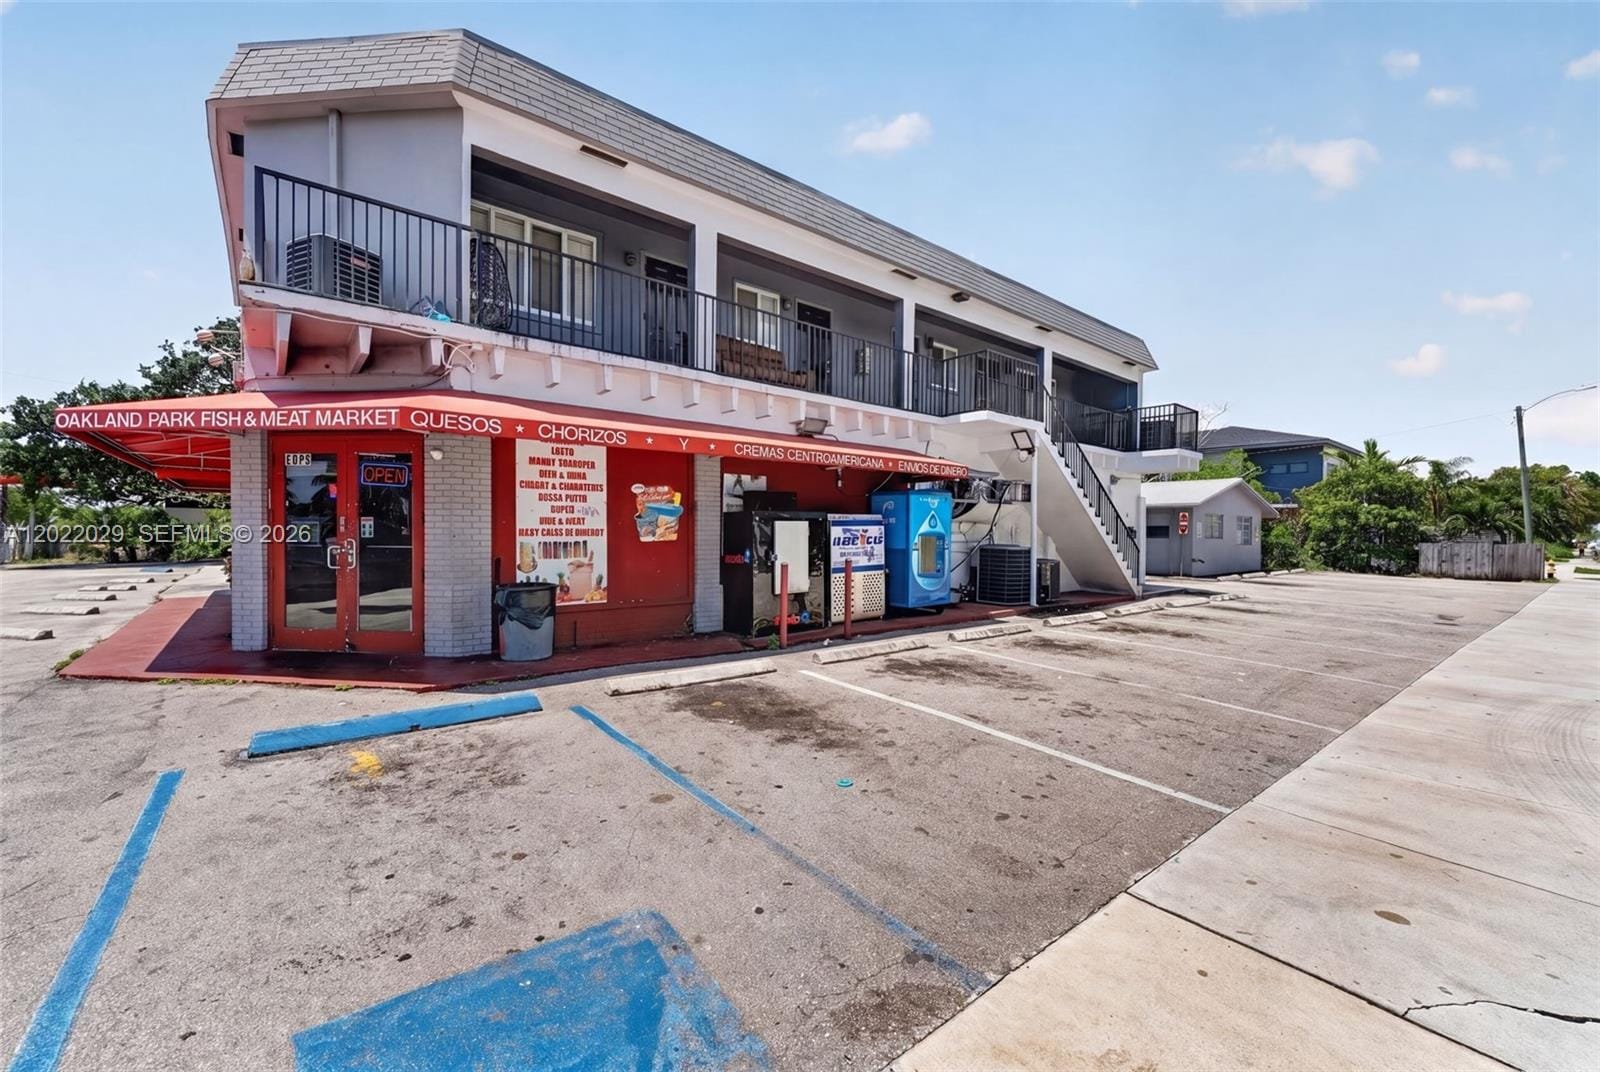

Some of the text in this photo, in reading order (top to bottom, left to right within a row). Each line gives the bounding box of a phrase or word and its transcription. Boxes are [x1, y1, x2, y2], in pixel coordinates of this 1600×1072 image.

[55, 408, 400, 428] OAKLAND PARK FISH & MEAT MARKET
[410, 410, 502, 434] QUESOS
[538, 423, 627, 445] CHORIZOS
[679, 437, 689, 450] Y
[734, 443, 784, 459] CREMAS
[787, 449, 884, 469] CENTROAMERICANA
[898, 460, 929, 474] ENVIOS
[929, 463, 940, 475] DE
[941, 464, 967, 477] DINERO
[364, 467, 405, 483] OPEN
